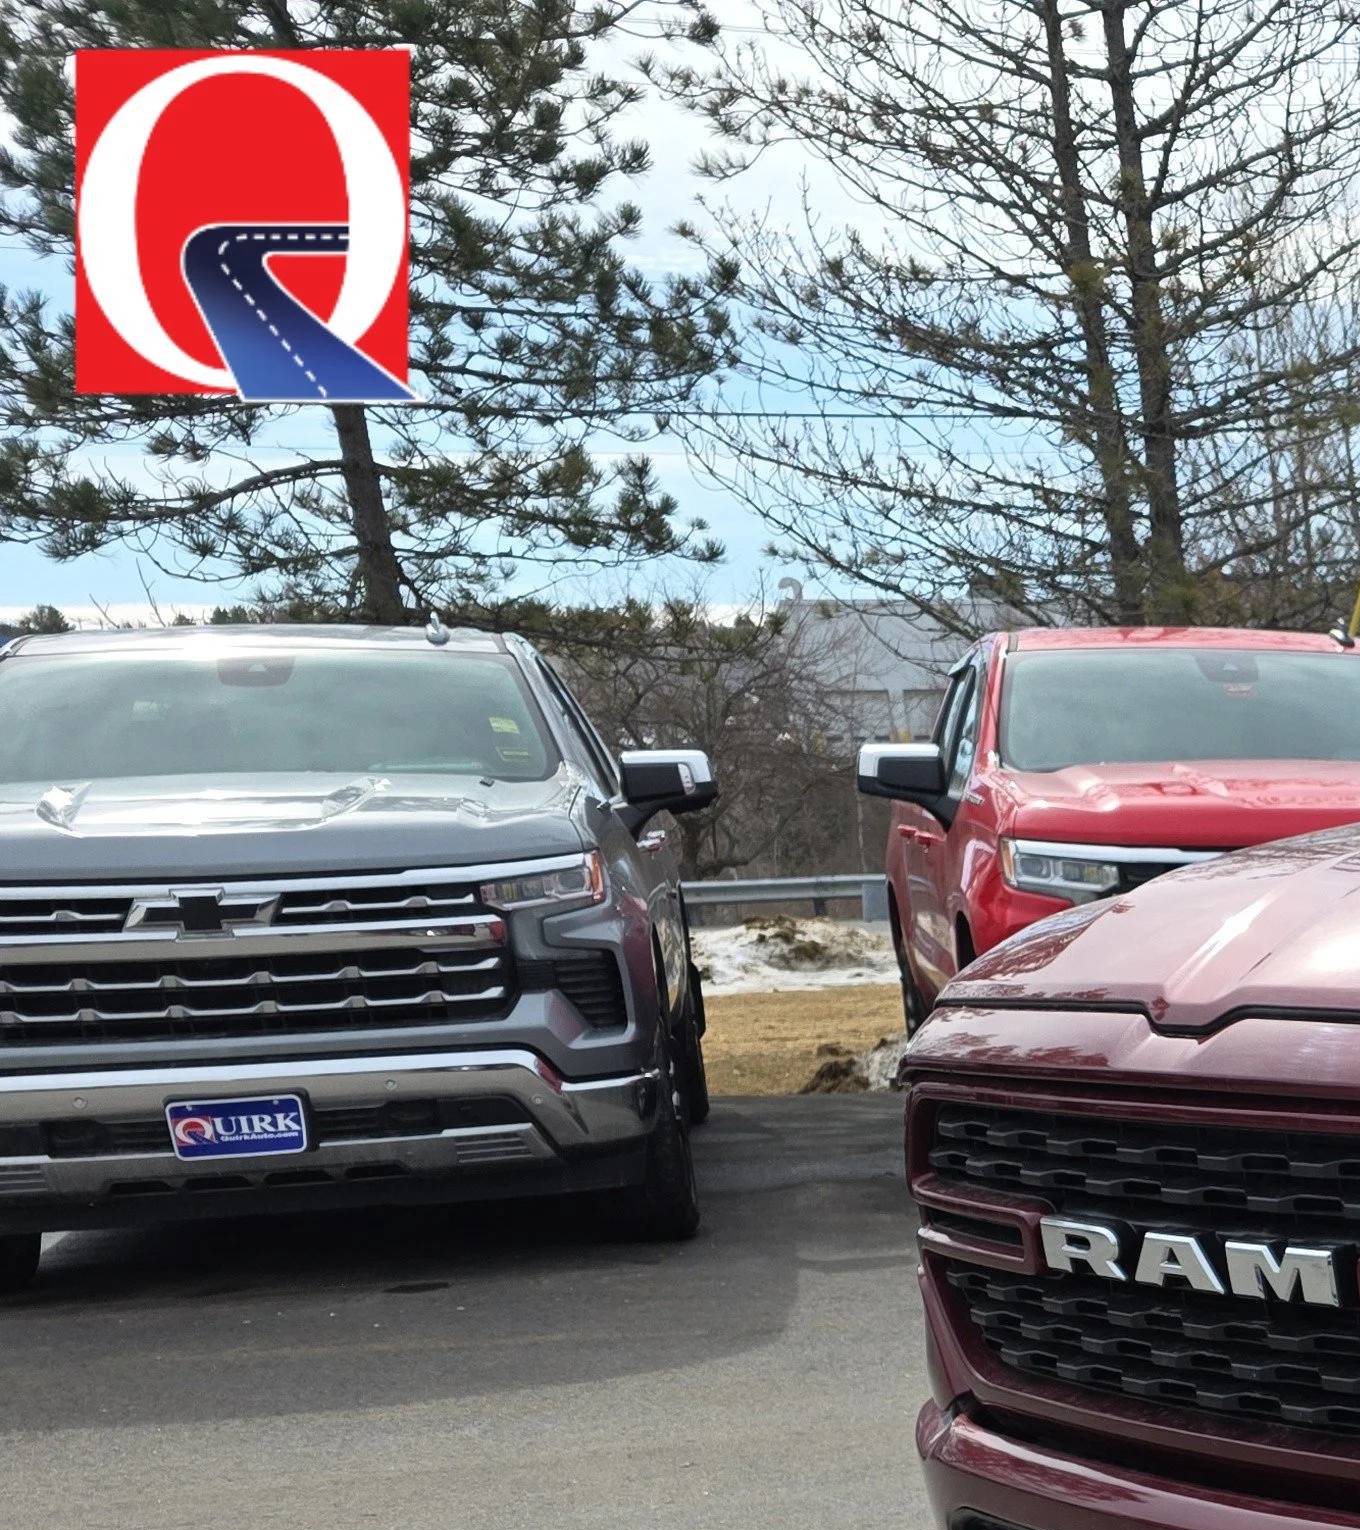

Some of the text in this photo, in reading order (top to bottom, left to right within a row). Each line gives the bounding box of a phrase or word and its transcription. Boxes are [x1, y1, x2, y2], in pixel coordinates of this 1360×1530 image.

[174, 1111, 302, 1146] QUIRK
[220, 1131, 300, 1143] QuirkAuto.com
[1040, 1217, 1343, 1309] RAM
